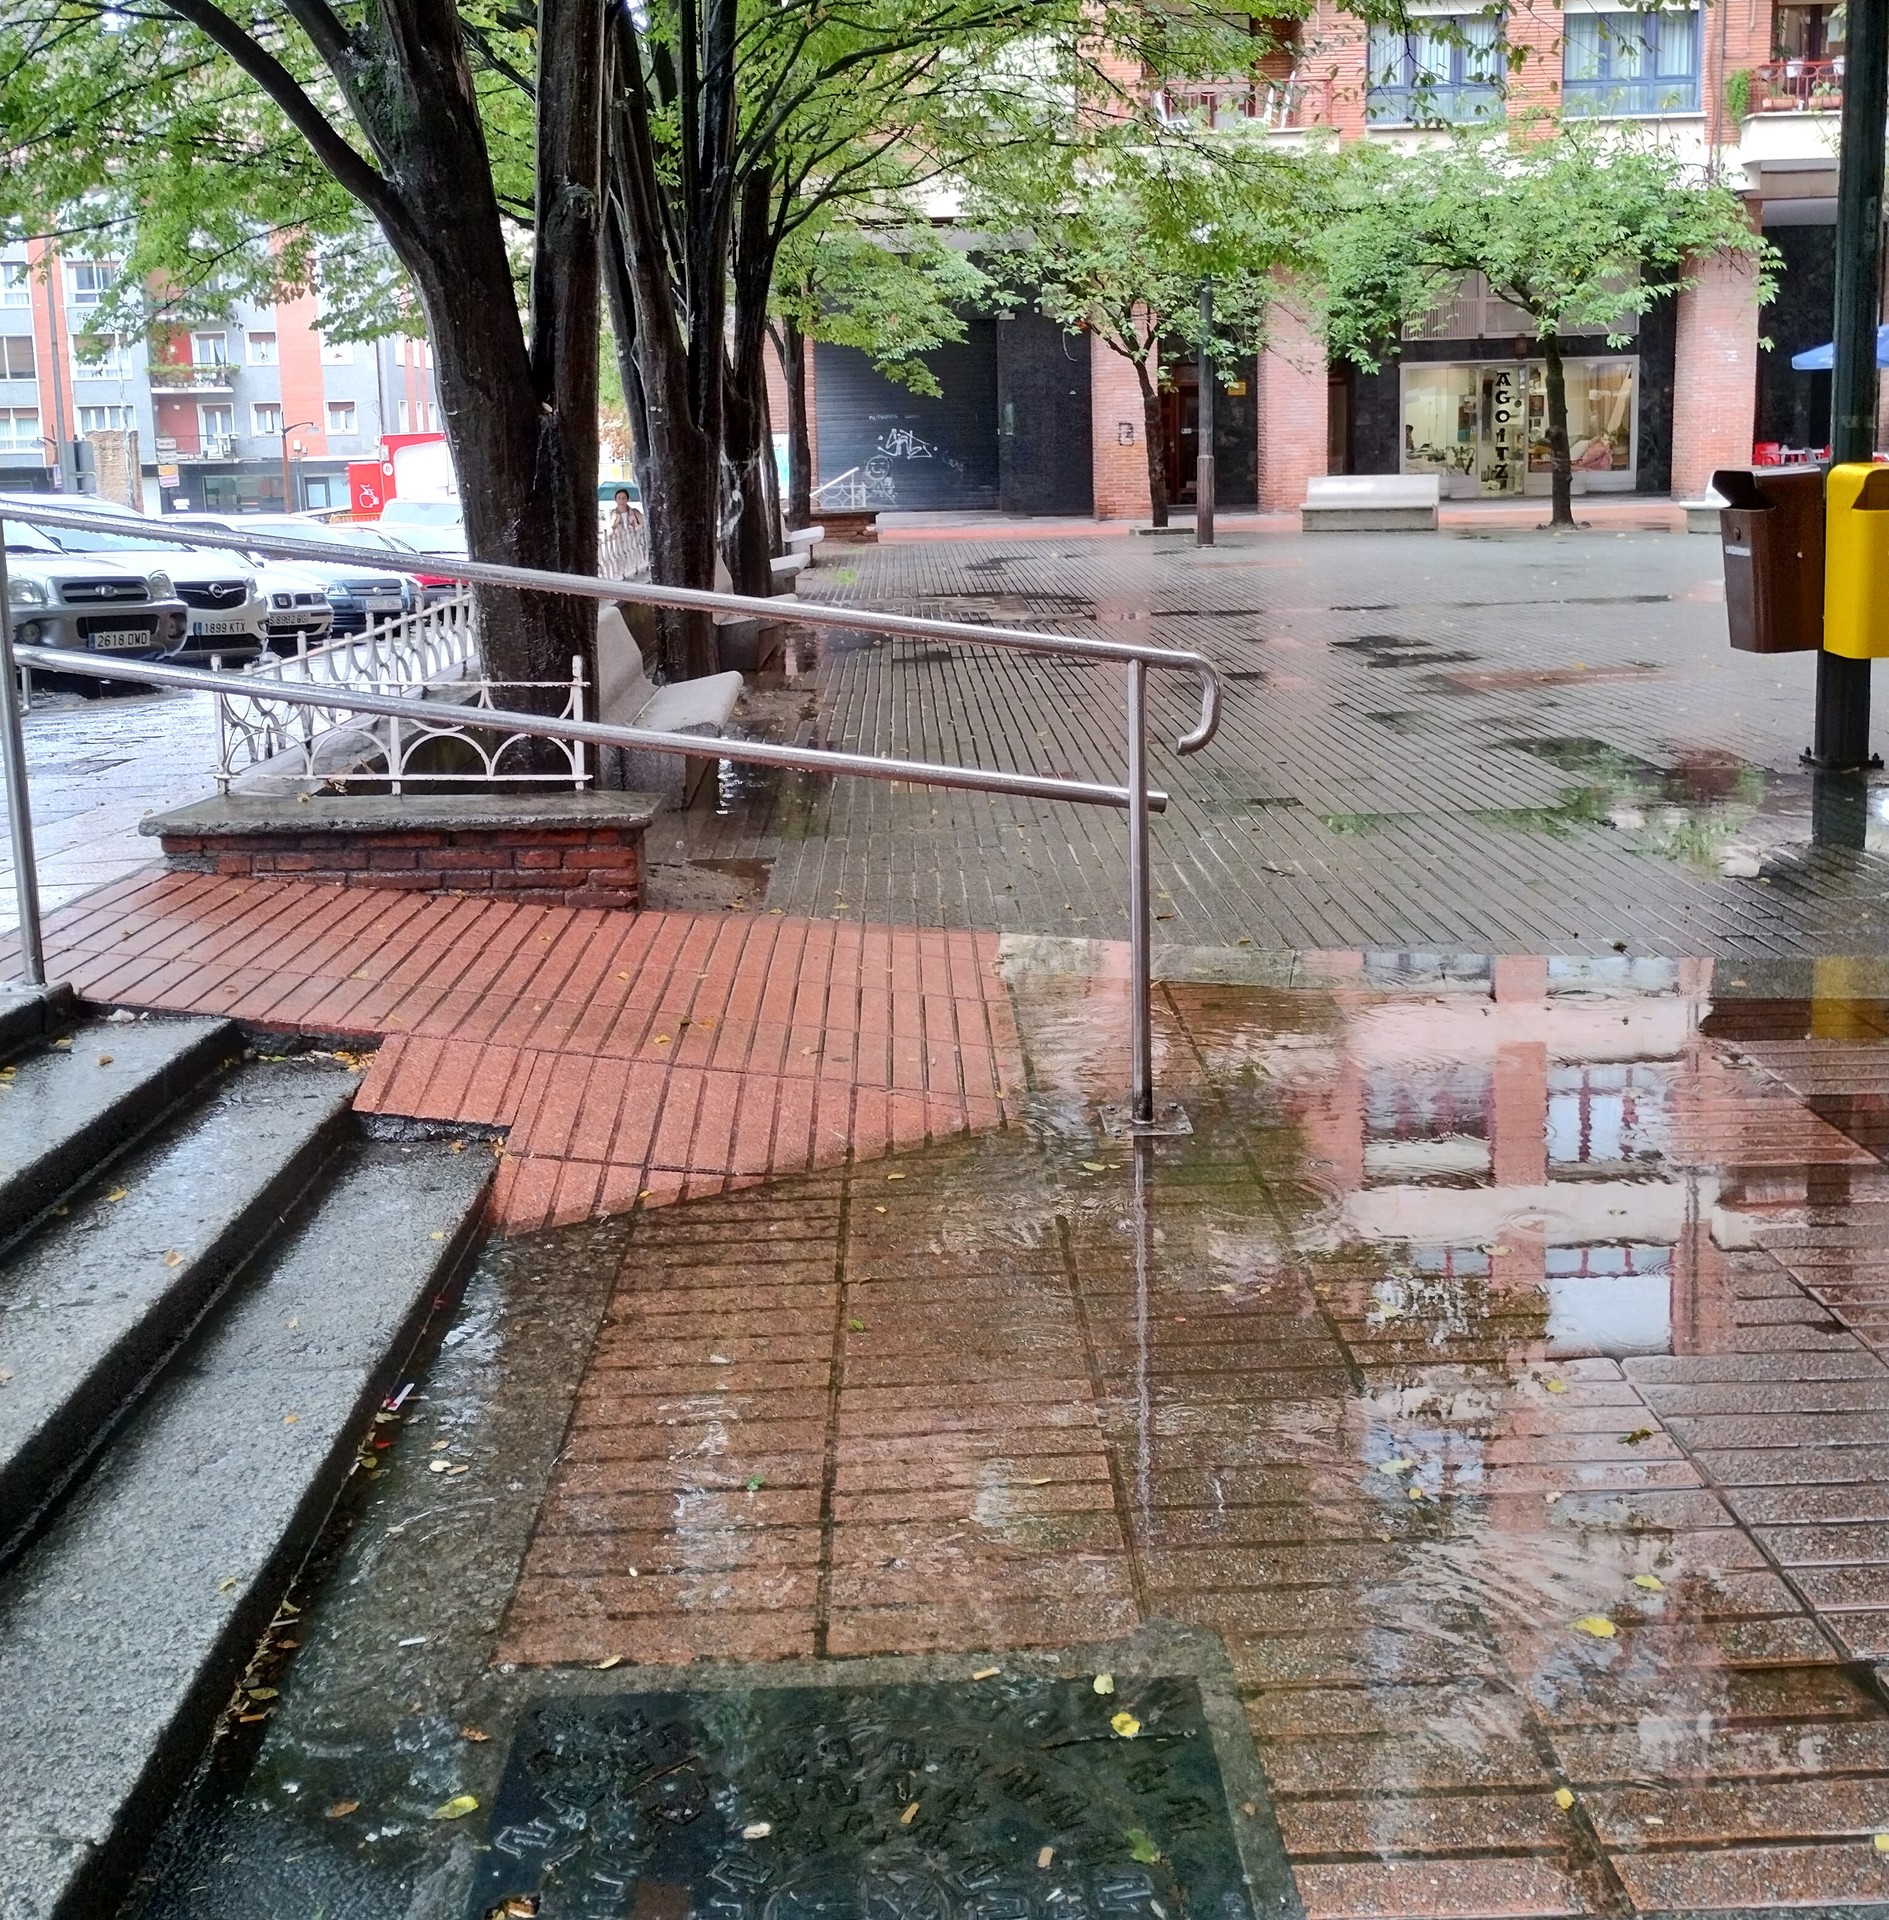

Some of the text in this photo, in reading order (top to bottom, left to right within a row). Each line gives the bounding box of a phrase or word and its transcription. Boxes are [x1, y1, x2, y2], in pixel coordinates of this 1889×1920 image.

[205, 622, 246, 634] 1899 KTX
[97, 634, 125, 648] 2618
